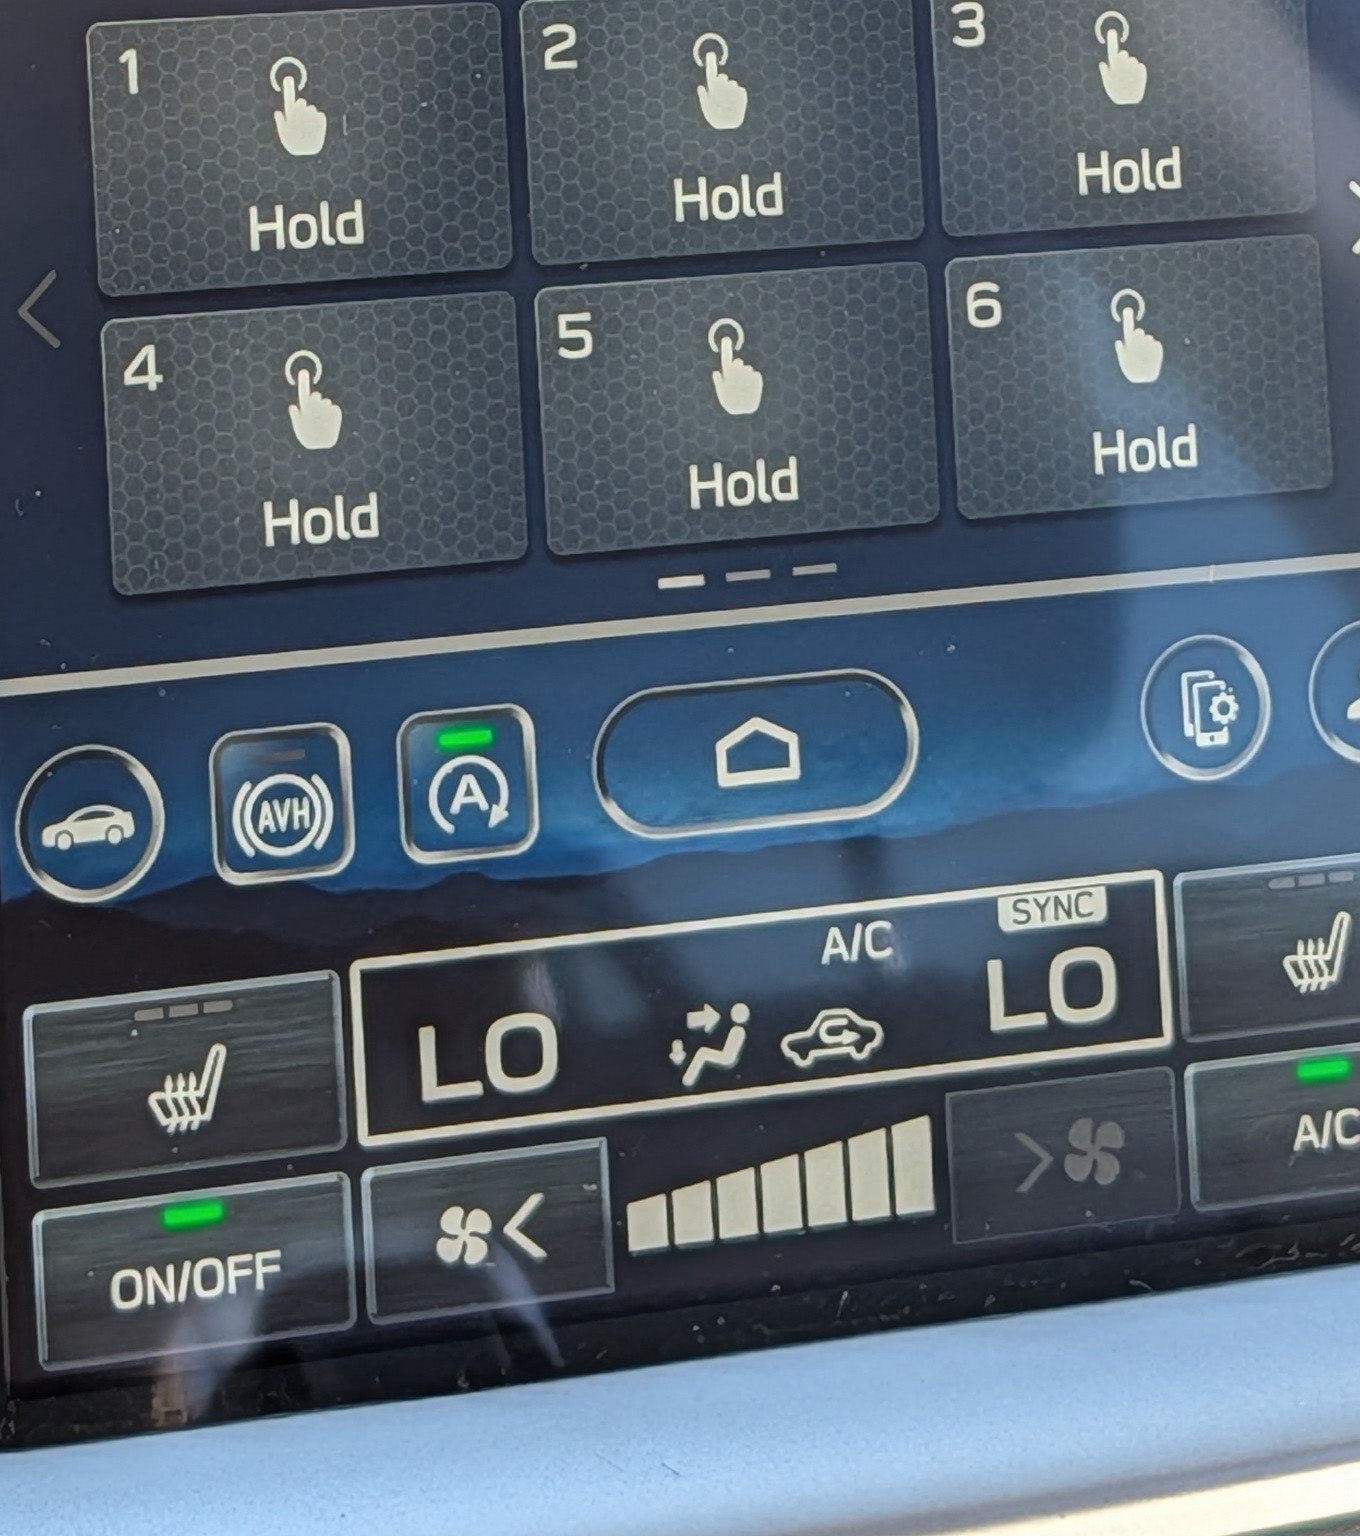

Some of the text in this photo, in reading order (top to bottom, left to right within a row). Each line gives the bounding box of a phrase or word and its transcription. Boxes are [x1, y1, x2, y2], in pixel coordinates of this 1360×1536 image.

[541, 22, 578, 71] 2
[951, 1, 987, 48] 3
[117, 47, 140, 95] 1
[1076, 145, 1184, 197] Hold
[672, 170, 786, 224] Hold
[248, 198, 367, 252] Hold
[965, 281, 1003, 329] 6
[556, 310, 595, 361] 5
[122, 343, 164, 393] 4
[1091, 421, 1200, 477] Hold
[687, 454, 801, 511] Hold
[263, 490, 381, 547] Hold
[256, 797, 311, 837] AVH
[1010, 888, 1096, 927] SYNC
[821, 919, 895, 965] A/C
[986, 945, 1119, 1035] LO
[417, 1011, 559, 1104] LO
[109, 1248, 283, 1315] ON/OFF
